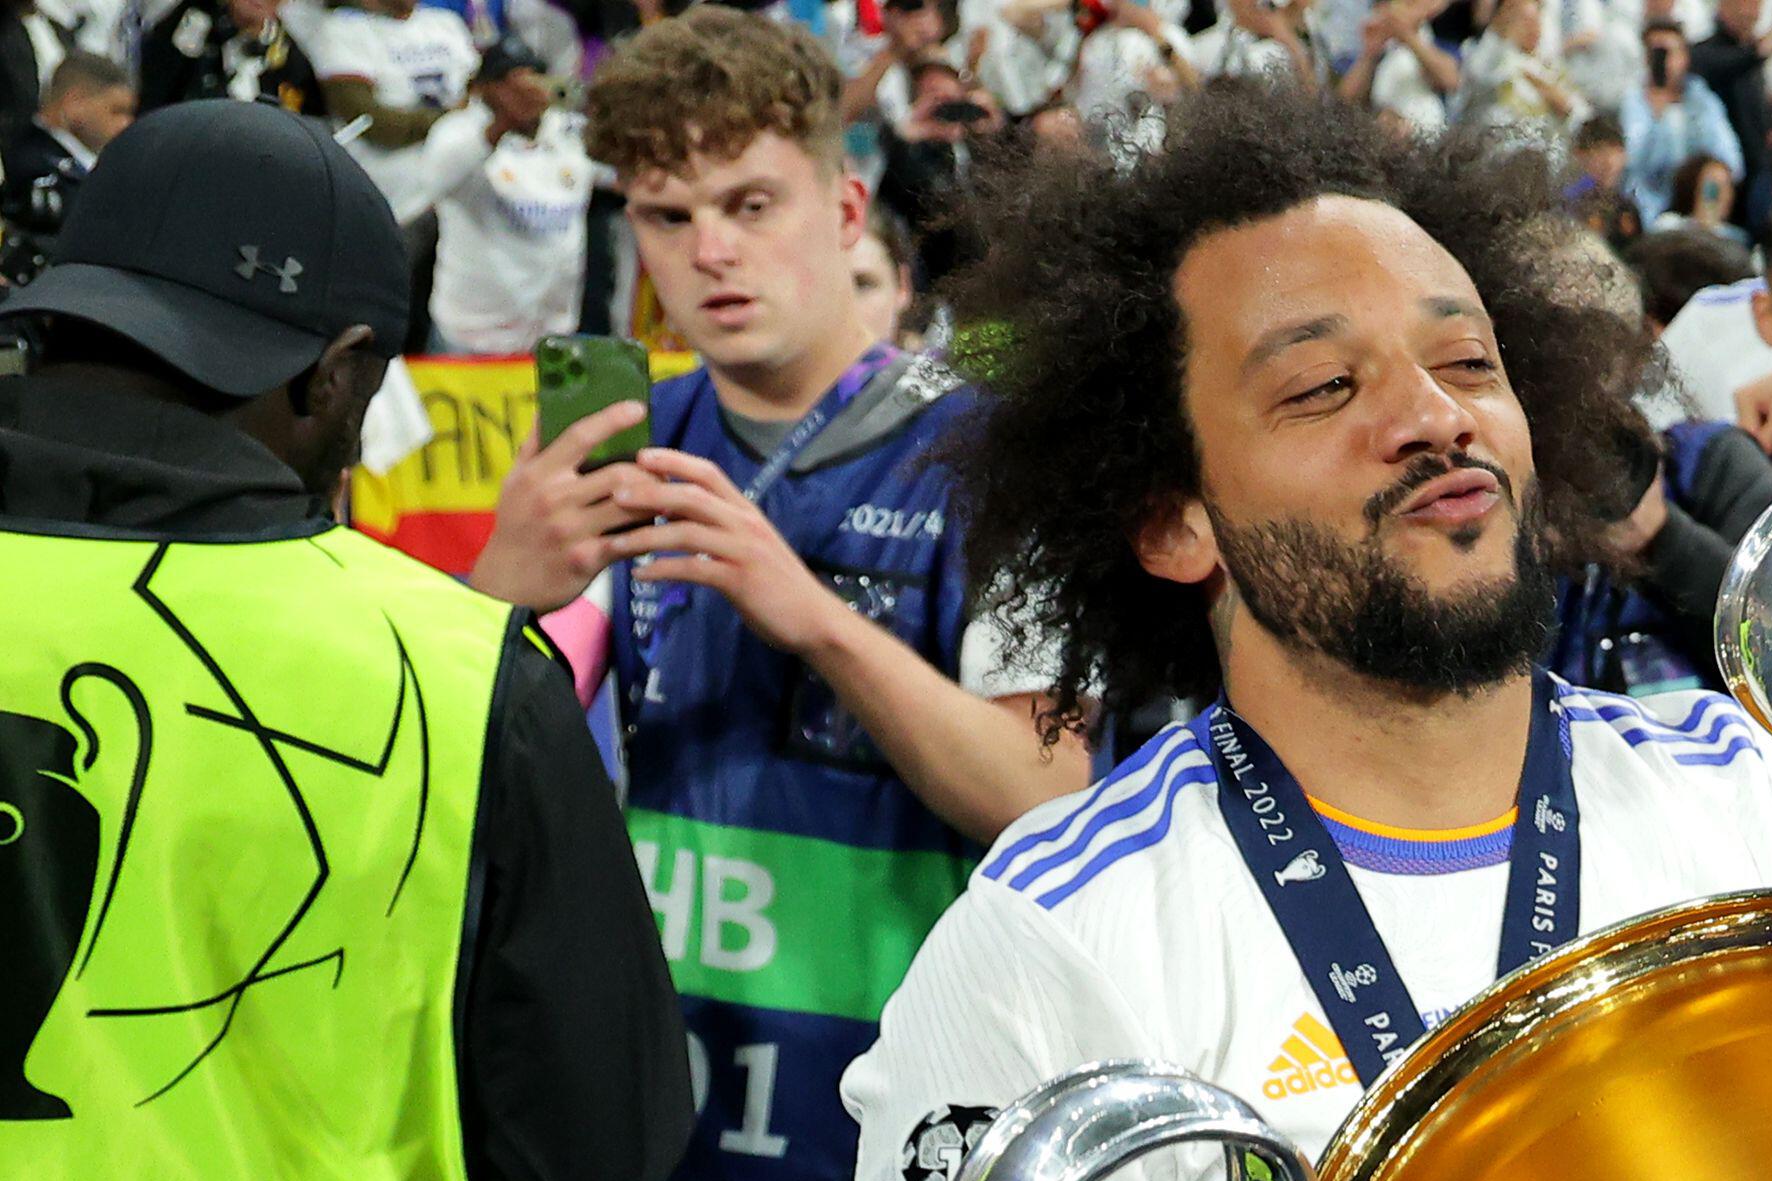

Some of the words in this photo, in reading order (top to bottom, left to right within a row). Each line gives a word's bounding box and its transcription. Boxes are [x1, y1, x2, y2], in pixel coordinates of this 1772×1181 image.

[1209, 721, 1255, 781] FINAL
[1244, 781, 1293, 846] 2022
[1531, 851, 1559, 933] PARIS
